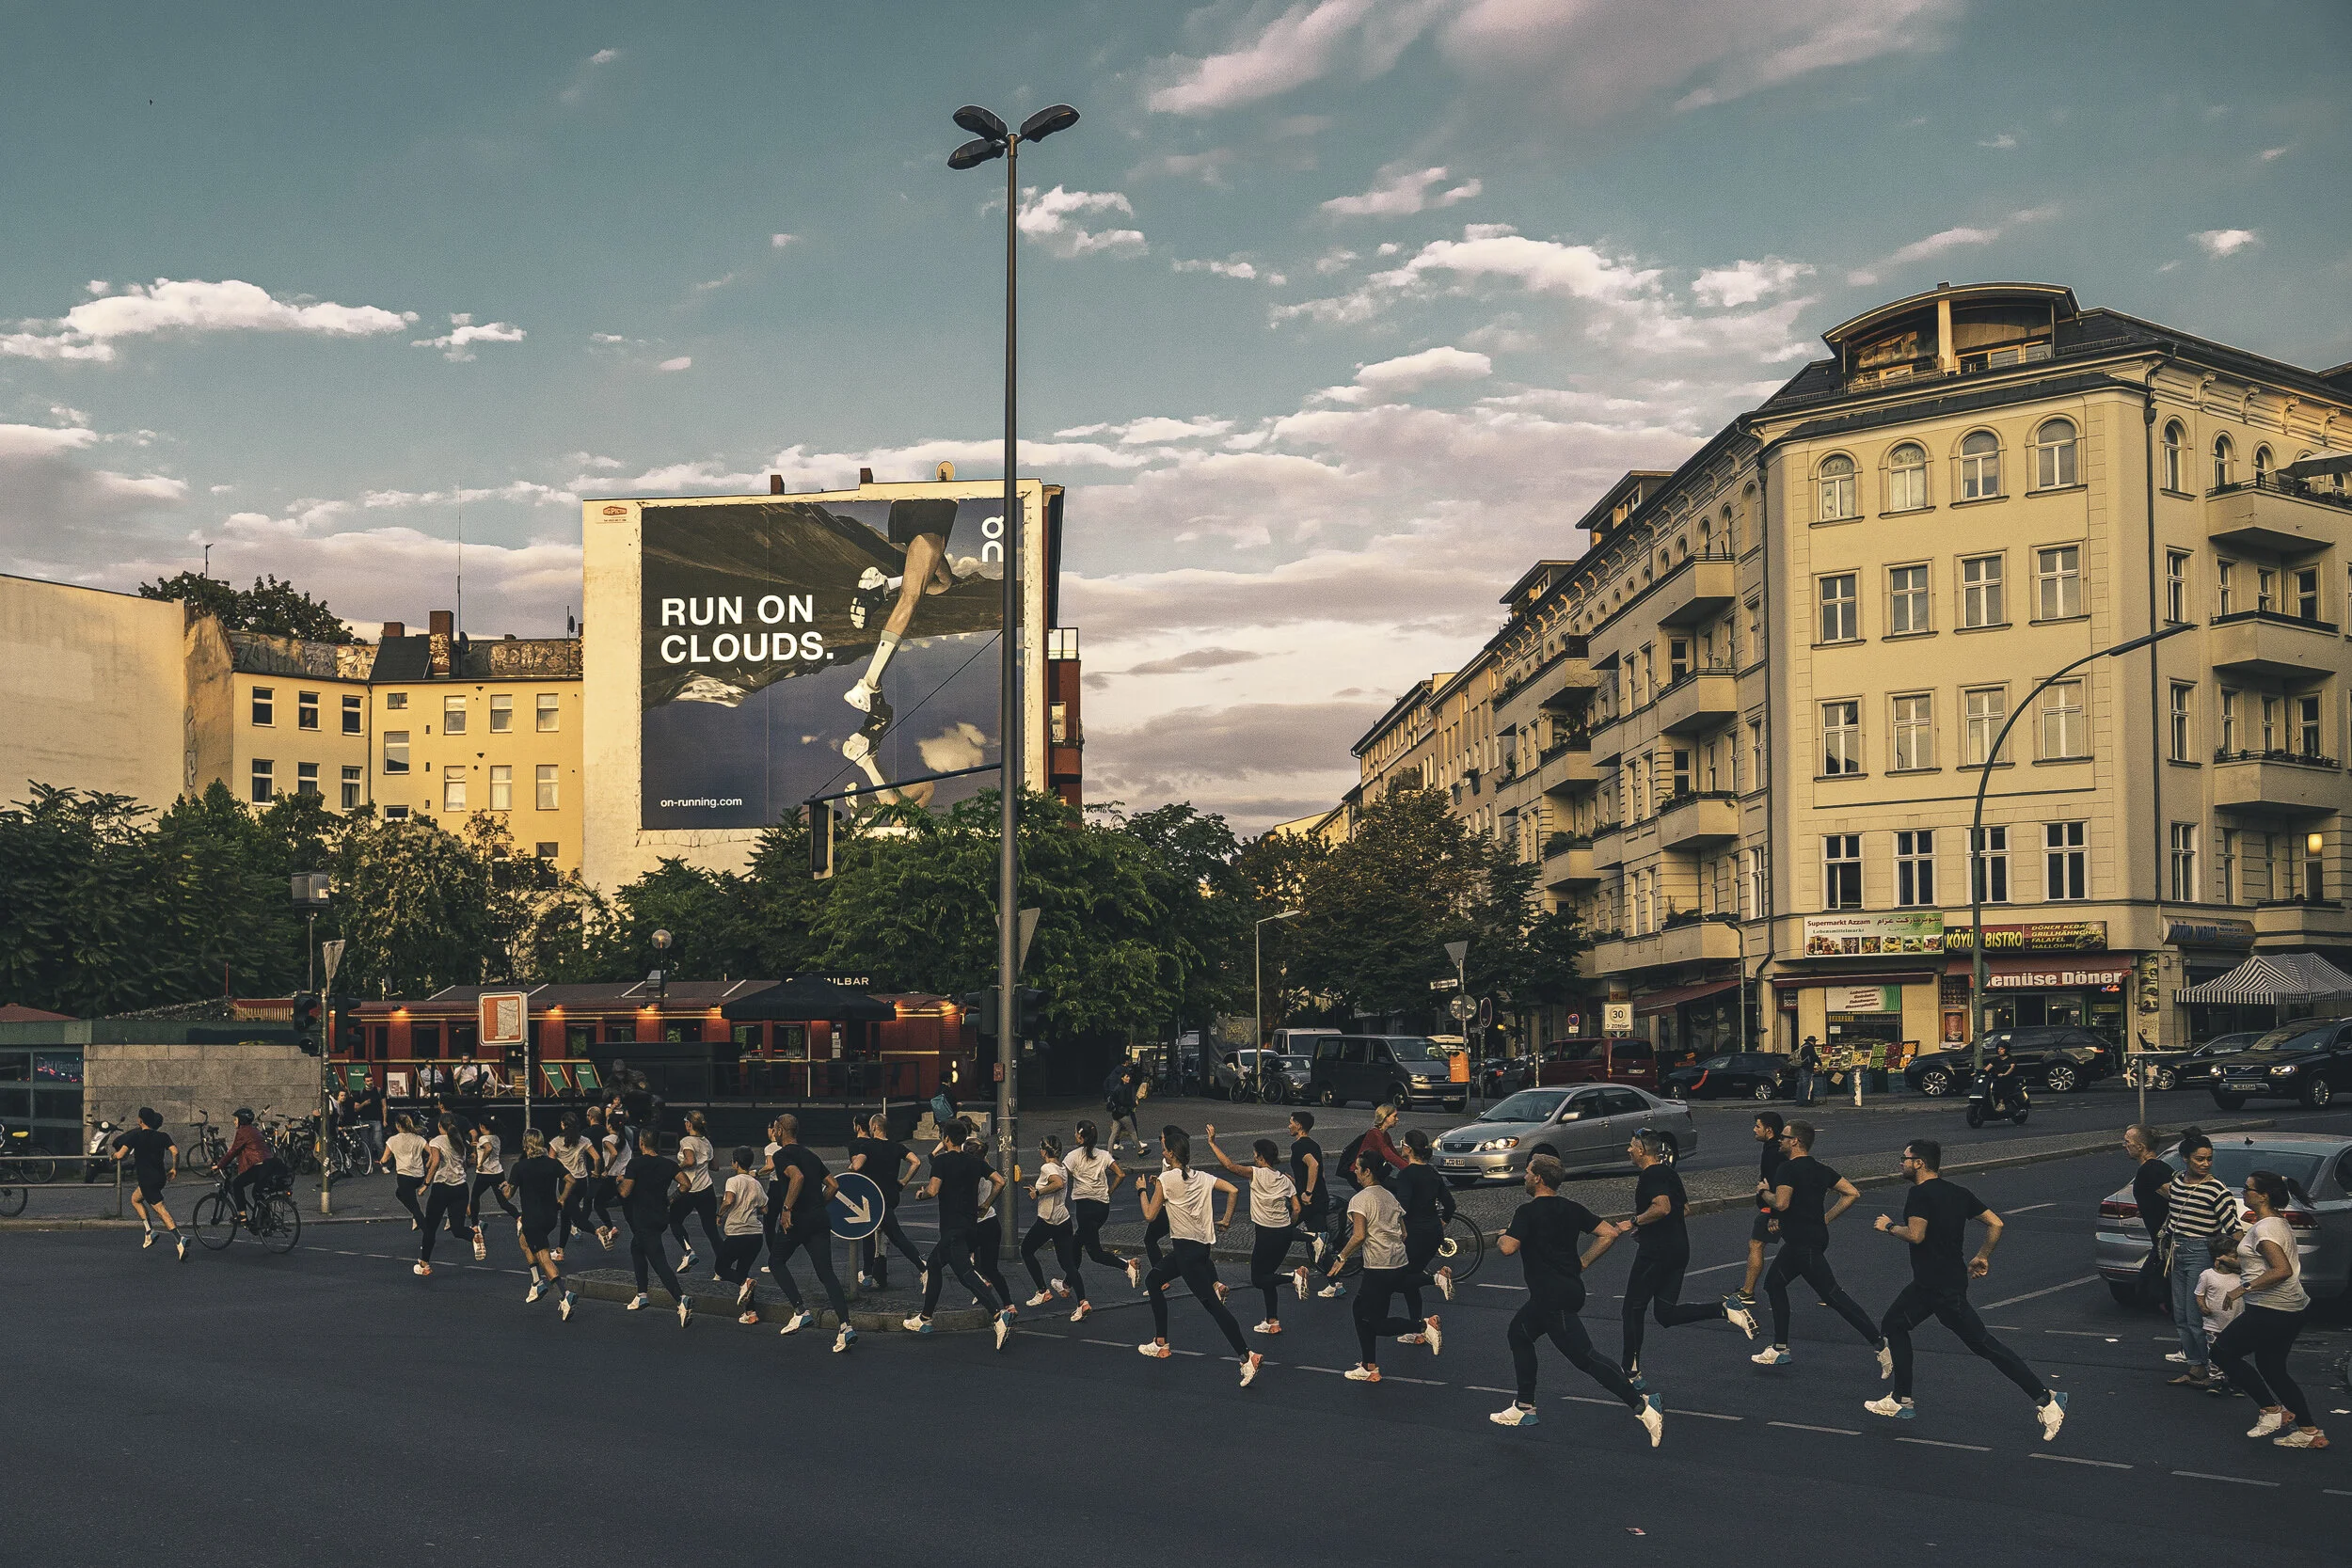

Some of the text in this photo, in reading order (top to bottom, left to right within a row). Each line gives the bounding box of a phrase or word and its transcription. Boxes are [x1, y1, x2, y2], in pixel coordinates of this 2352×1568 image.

[661, 594, 813, 626] RUN ON
[660, 631, 834, 664] CLOUDS.
[660, 797, 742, 808] on-running.com
[1807, 919, 1847, 927] Supermarkt
[1947, 929, 2022, 949] KÖYÜ BISTRO
[1987, 972, 2122, 987] emüse Döner
[1613, 1010, 1623, 1019] 30
